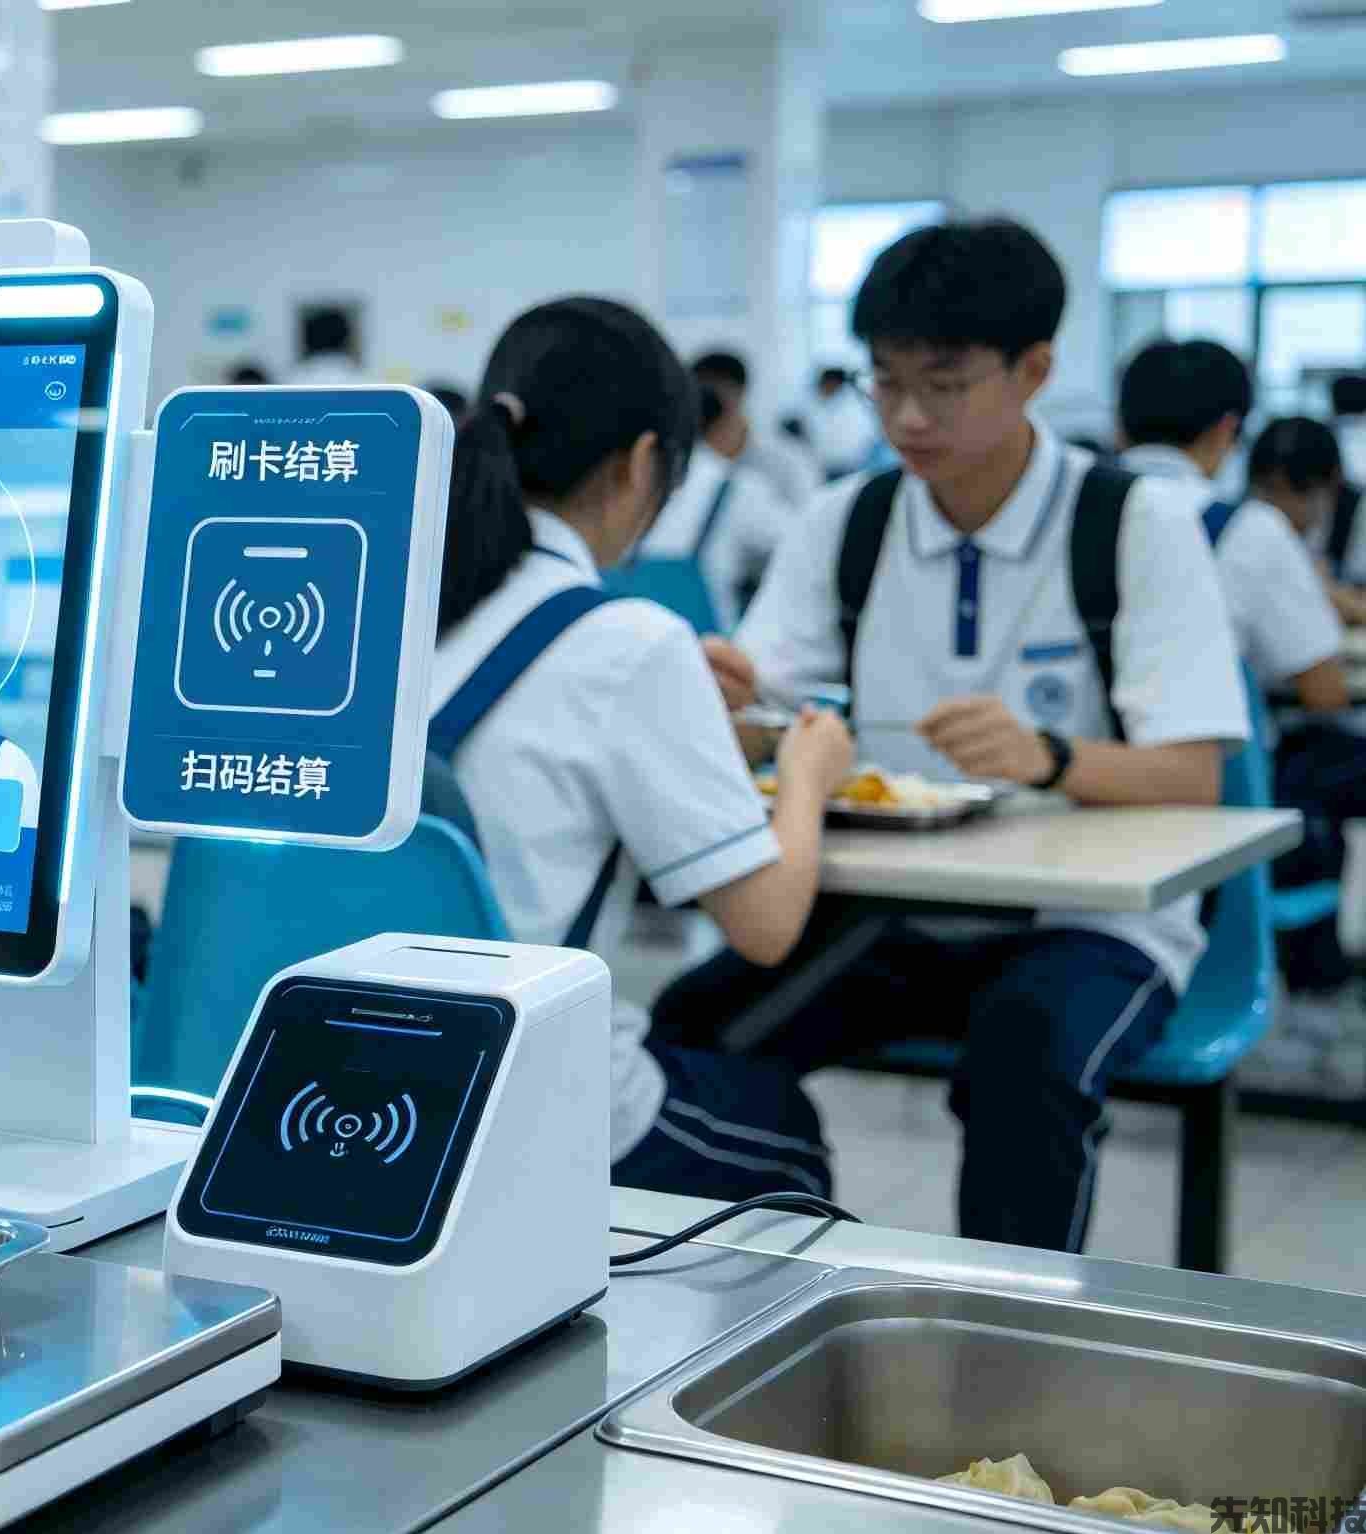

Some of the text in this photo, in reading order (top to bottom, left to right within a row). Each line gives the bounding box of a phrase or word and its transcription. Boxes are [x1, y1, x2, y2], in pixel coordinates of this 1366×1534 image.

[208, 439, 360, 483] 刷卡结算
[180, 750, 331, 800] 扫码结算
